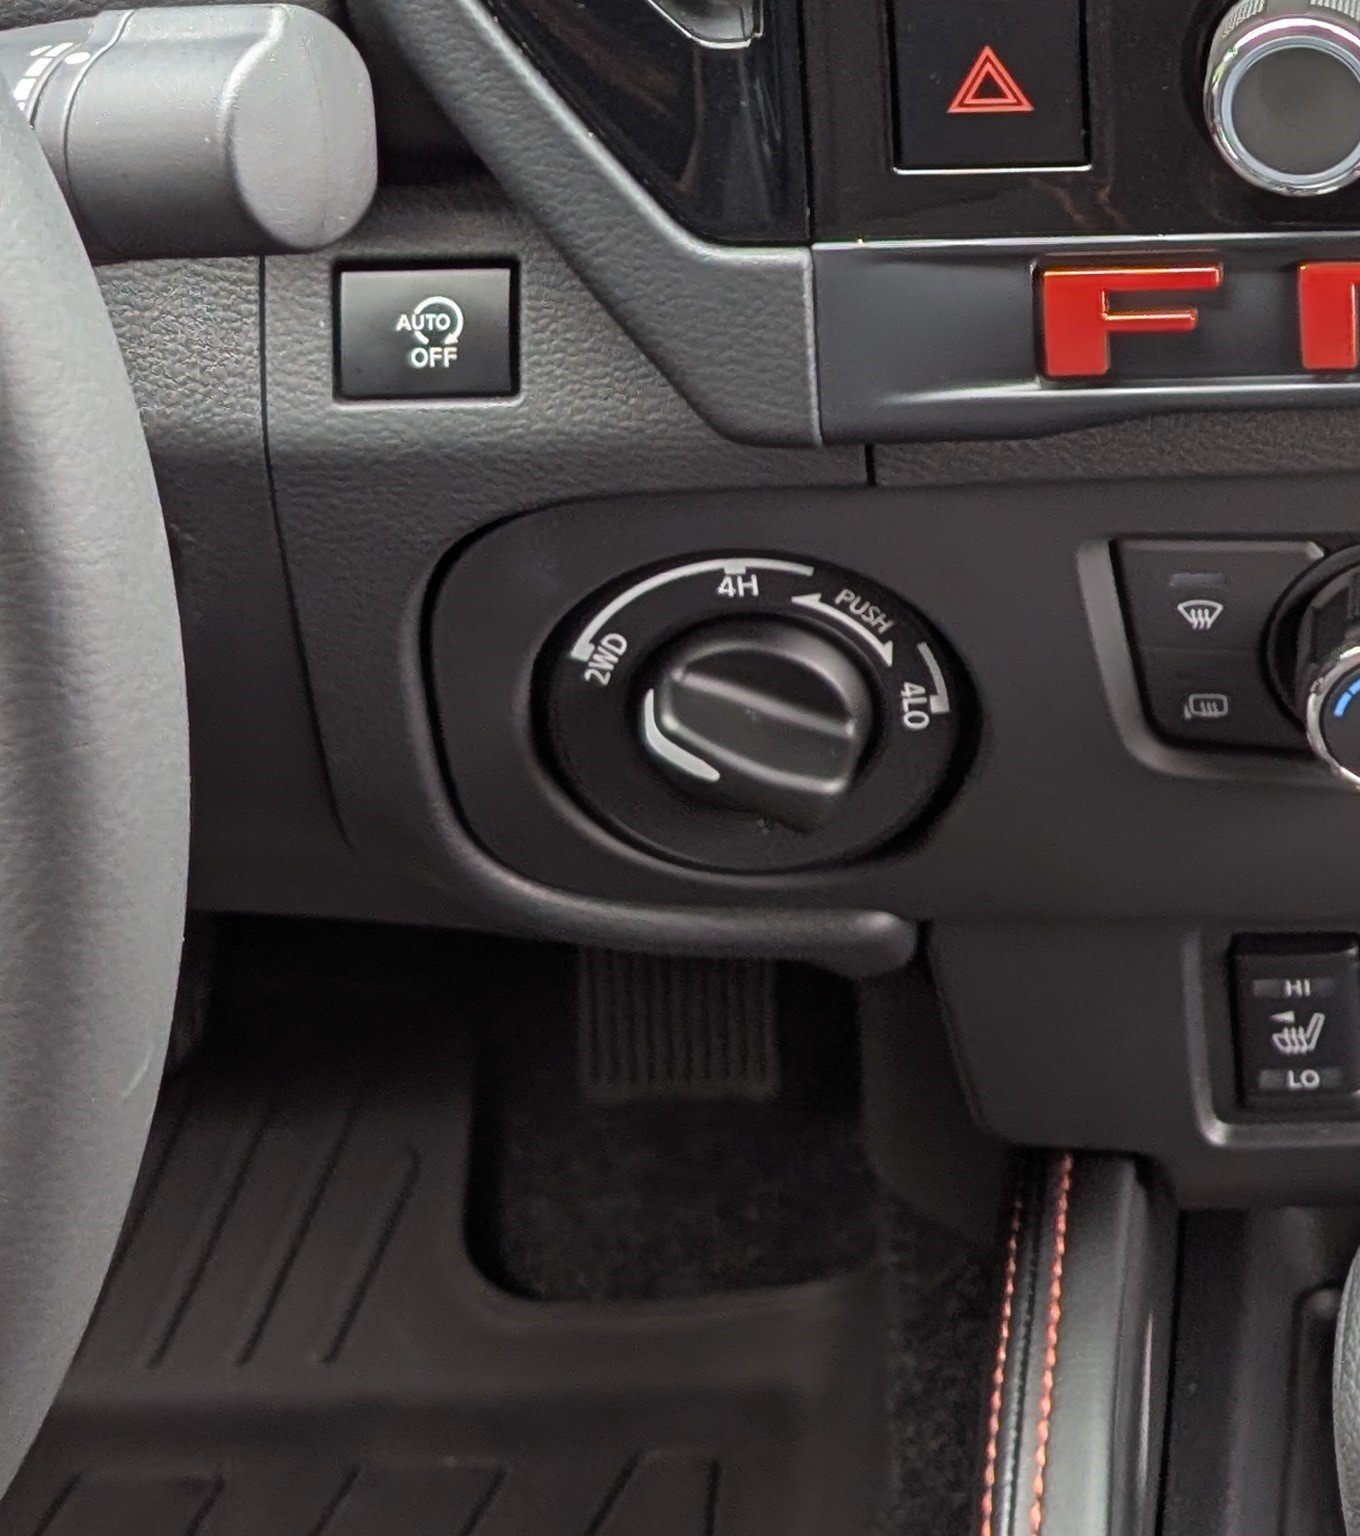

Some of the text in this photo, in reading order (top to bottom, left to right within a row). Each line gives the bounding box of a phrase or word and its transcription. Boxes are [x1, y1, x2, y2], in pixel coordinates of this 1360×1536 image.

[397, 313, 451, 332] AUTO
[411, 346, 459, 368] OFF
[717, 574, 759, 599] 4H
[833, 588, 894, 635] PUSH
[583, 632, 629, 687] 2WD
[900, 680, 931, 731] 4LO
[1282, 979, 1312, 996] HI
[1287, 1072, 1320, 1089] LO
